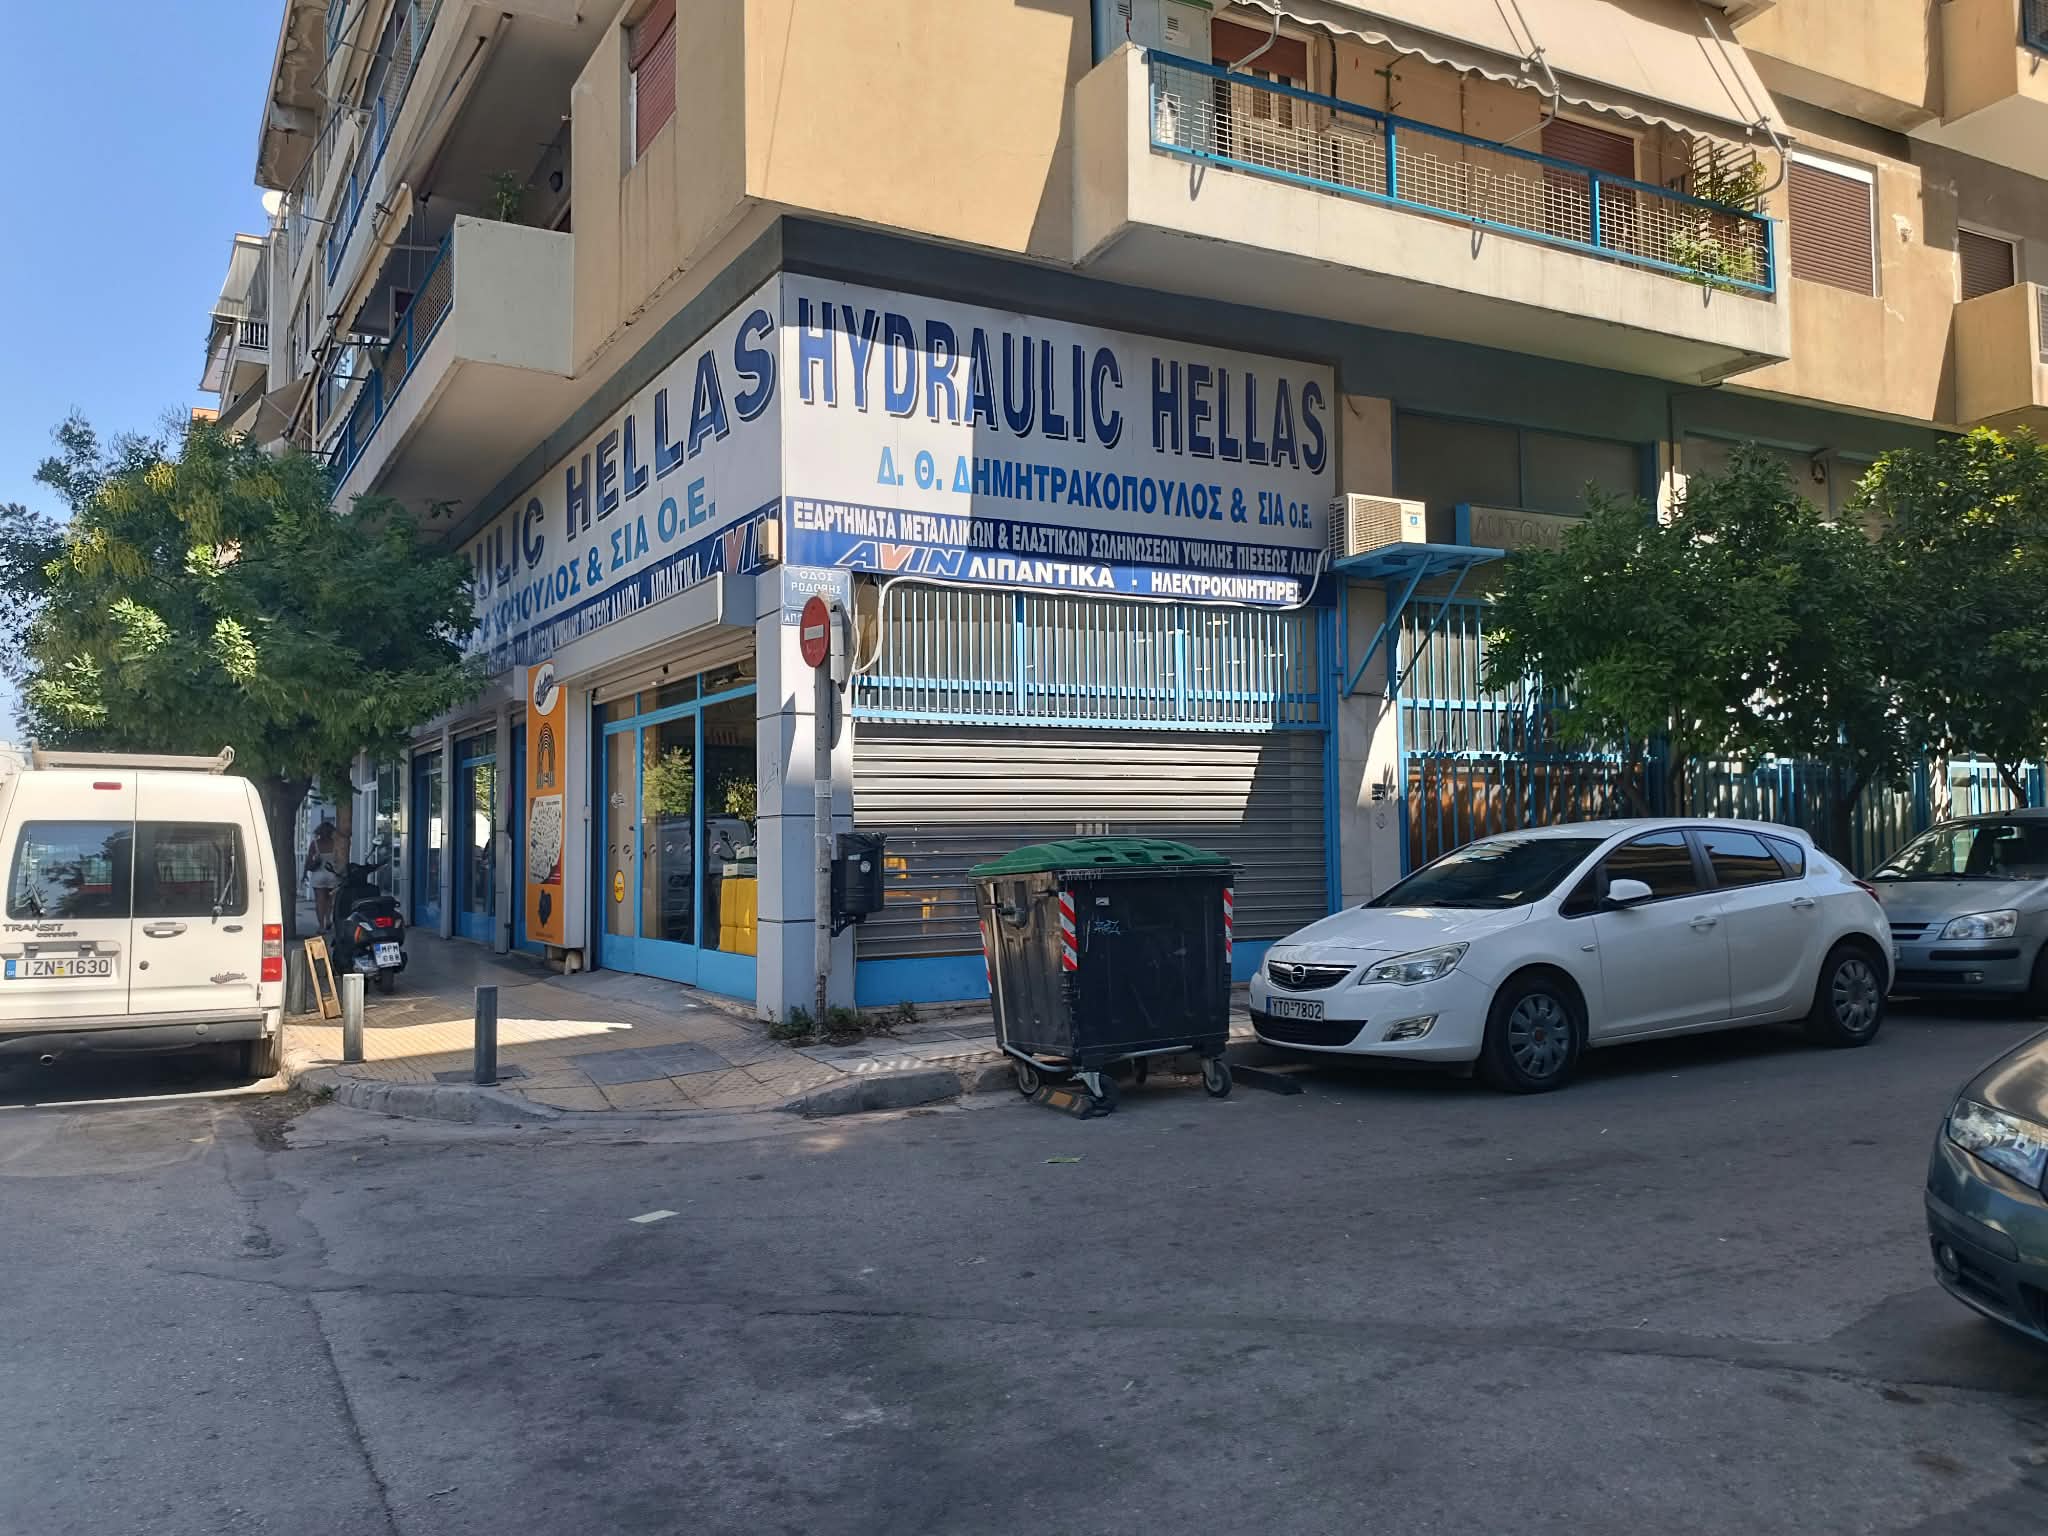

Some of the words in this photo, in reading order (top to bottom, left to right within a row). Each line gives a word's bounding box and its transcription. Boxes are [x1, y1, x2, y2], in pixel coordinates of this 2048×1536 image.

[798, 297, 1123, 450] HYDRAULIC
[1151, 356, 1329, 476] HELLAS
[566, 309, 777, 542] HELLAS
[877, 446, 904, 486] Δ.
[914, 450, 943, 491] Θ.
[952, 456, 1223, 521] ΔΗΜΗΤΡΑΚΟΠΟΥΛΟΣ
[1230, 487, 1248, 524] &
[1258, 491, 1285, 527] ΣΙΑ
[586, 547, 603, 587] &
[611, 514, 650, 572] ΣΙΑ
[657, 476, 716, 544] Ο.Ε.
[794, 500, 897, 540] ΕΞΑΡΤΗΜΑΤΑ
[900, 513, 994, 548] ΜΕΤΑΛΛΙΚΩΝ
[997, 522, 1009, 550] &
[1012, 524, 1087, 557] ΕΛΑΣΤΙΚΩΝ
[1090, 531, 1179, 566] ΣΩΛΗΝΩΣΕΩΝ
[1182, 540, 1234, 569] ΥΨΗΛΗΣ
[1236, 546, 1289, 573] ΠΙΕΣΕΩΣ
[834, 540, 966, 577] AVIN
[800, 570, 832, 582] ΟΔΟΣ
[967, 556, 1115, 588] ΛΙΠΑΝΤΙΚΑ
[3, 923, 64, 932] TRANSIT
